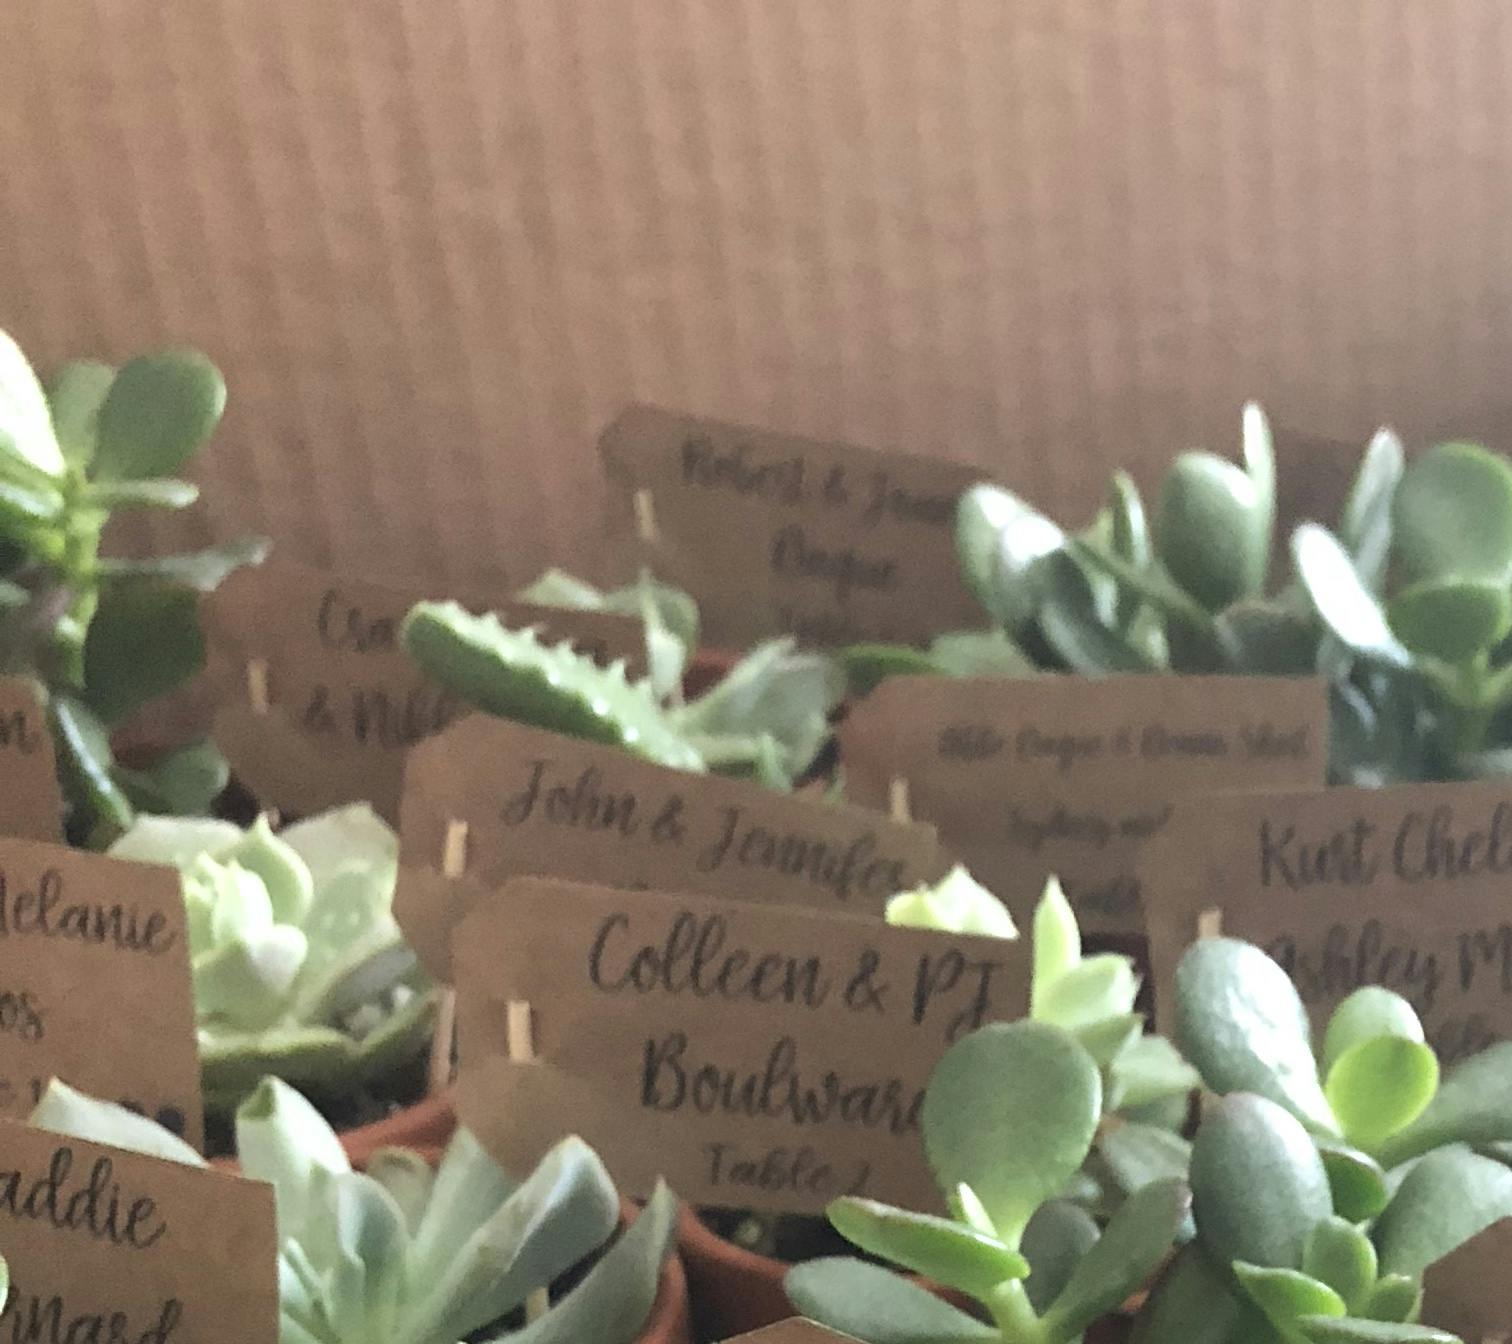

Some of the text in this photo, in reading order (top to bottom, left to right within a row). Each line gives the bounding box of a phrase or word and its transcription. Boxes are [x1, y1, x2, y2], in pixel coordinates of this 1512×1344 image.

[501, 759, 641, 837] John
[651, 796, 687, 845] &
[1259, 817, 1381, 891] Kurt
[0, 868, 176, 955] elanie
[588, 912, 1004, 1044] Colleen & PJ
[703, 1144, 832, 1192] Table
